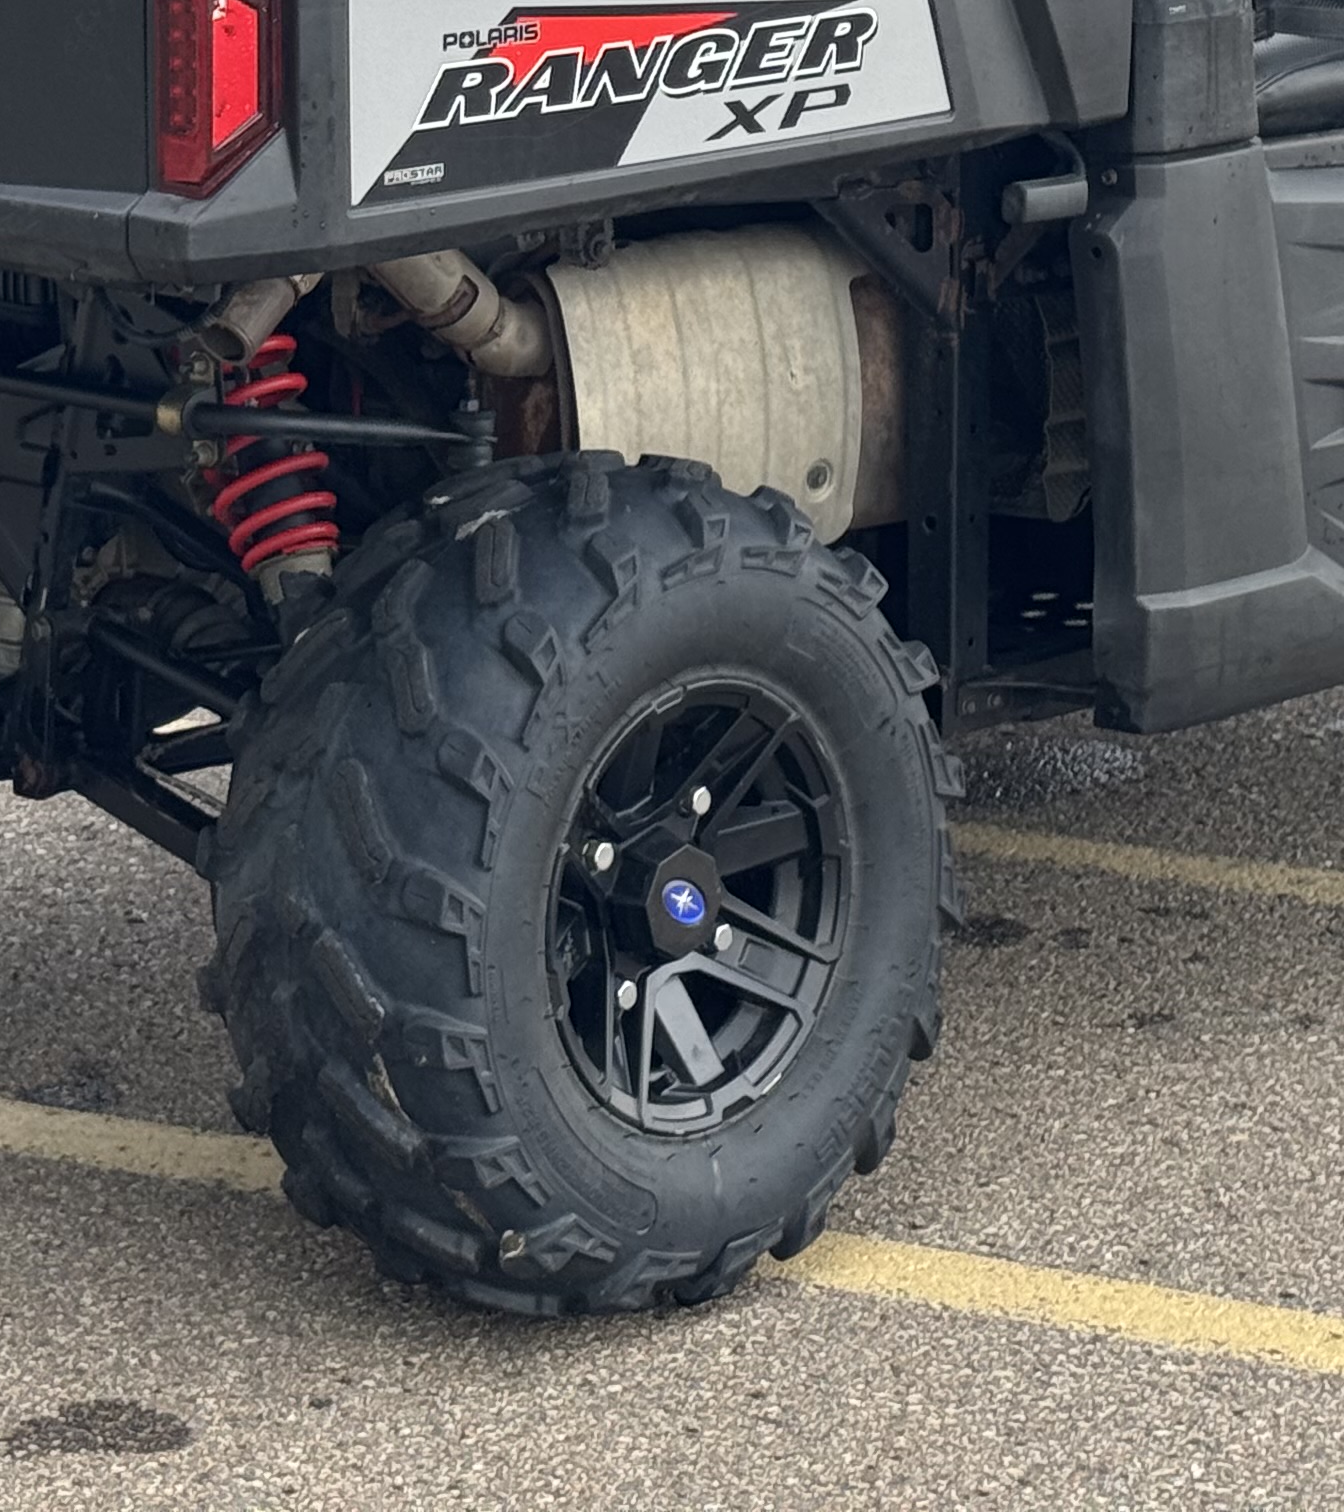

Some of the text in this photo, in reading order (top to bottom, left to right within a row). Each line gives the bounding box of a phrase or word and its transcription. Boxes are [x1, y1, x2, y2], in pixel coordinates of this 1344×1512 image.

[442, 23, 539, 52] POLARIS
[412, 8, 878, 131] RANGER
[705, 83, 852, 142] XP
